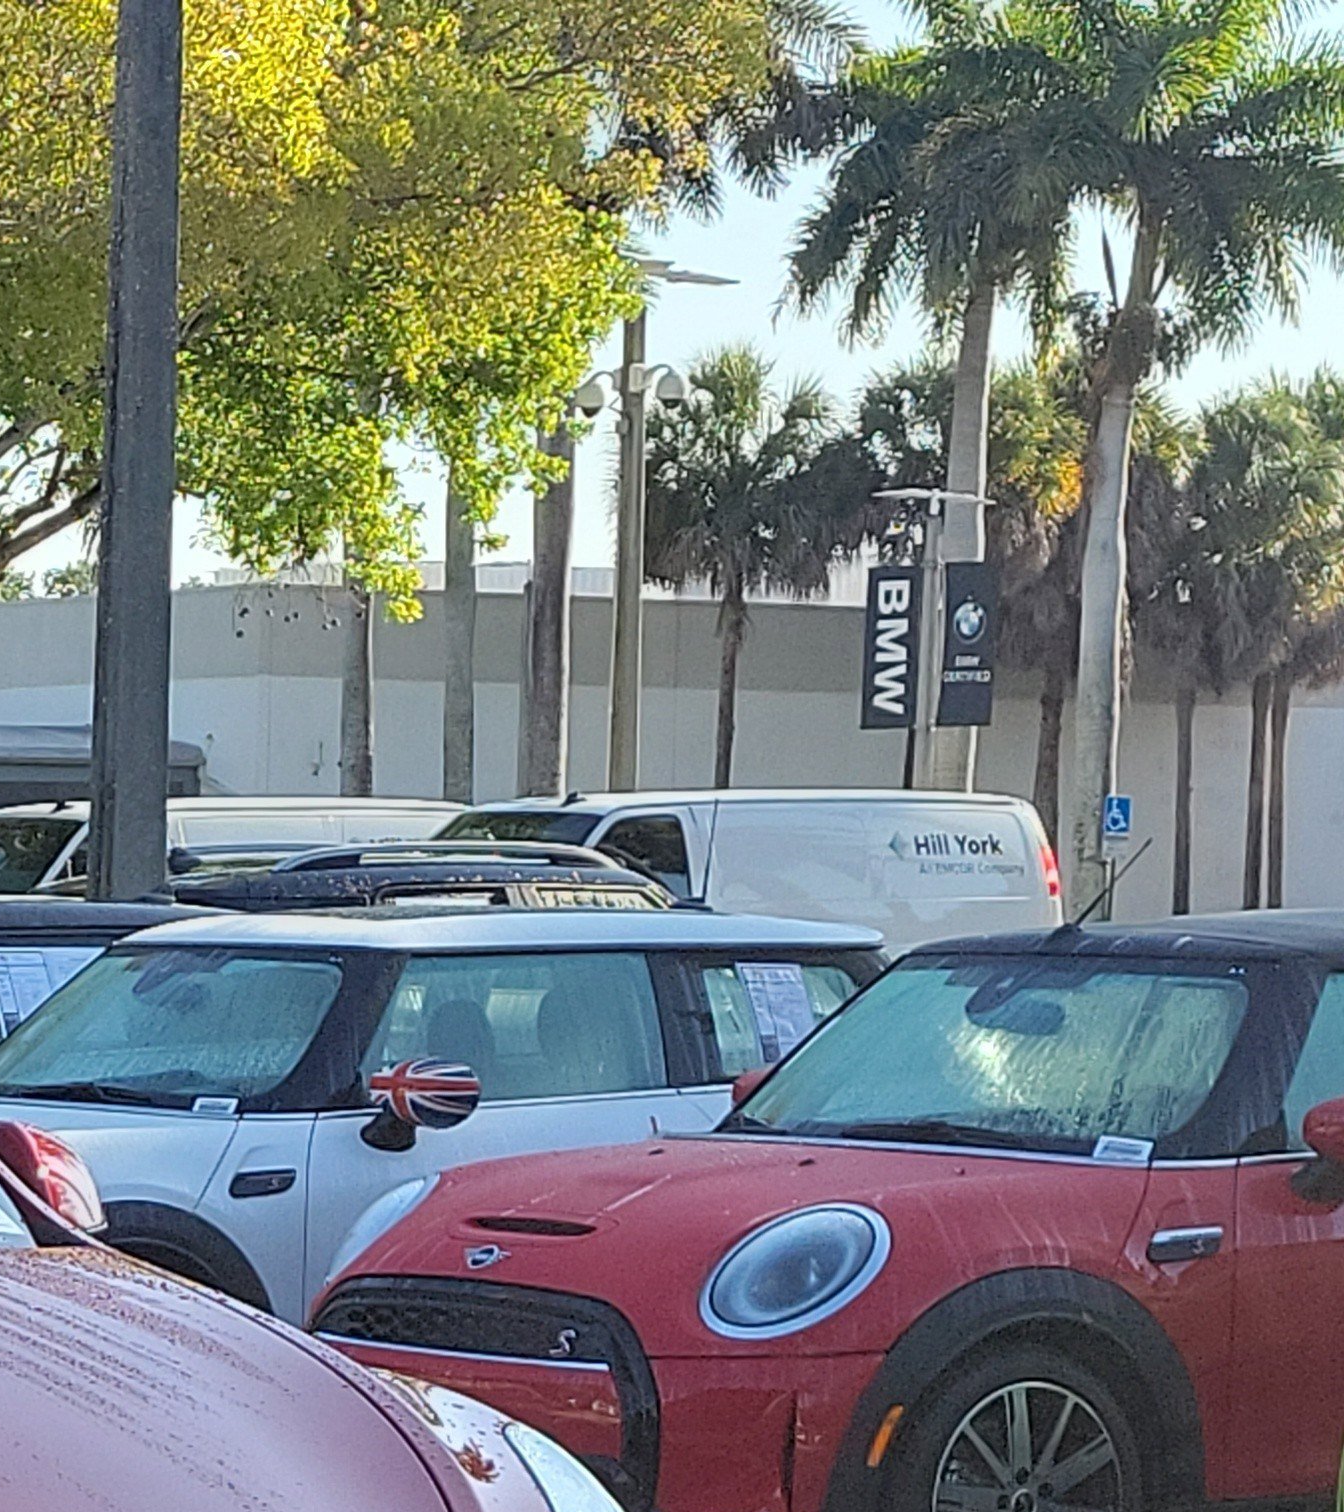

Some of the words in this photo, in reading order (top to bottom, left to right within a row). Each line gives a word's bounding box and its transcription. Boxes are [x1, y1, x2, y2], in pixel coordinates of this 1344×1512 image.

[873, 579, 911, 715] BMW
[914, 834, 950, 855] Hill
[954, 834, 1003, 856] York
